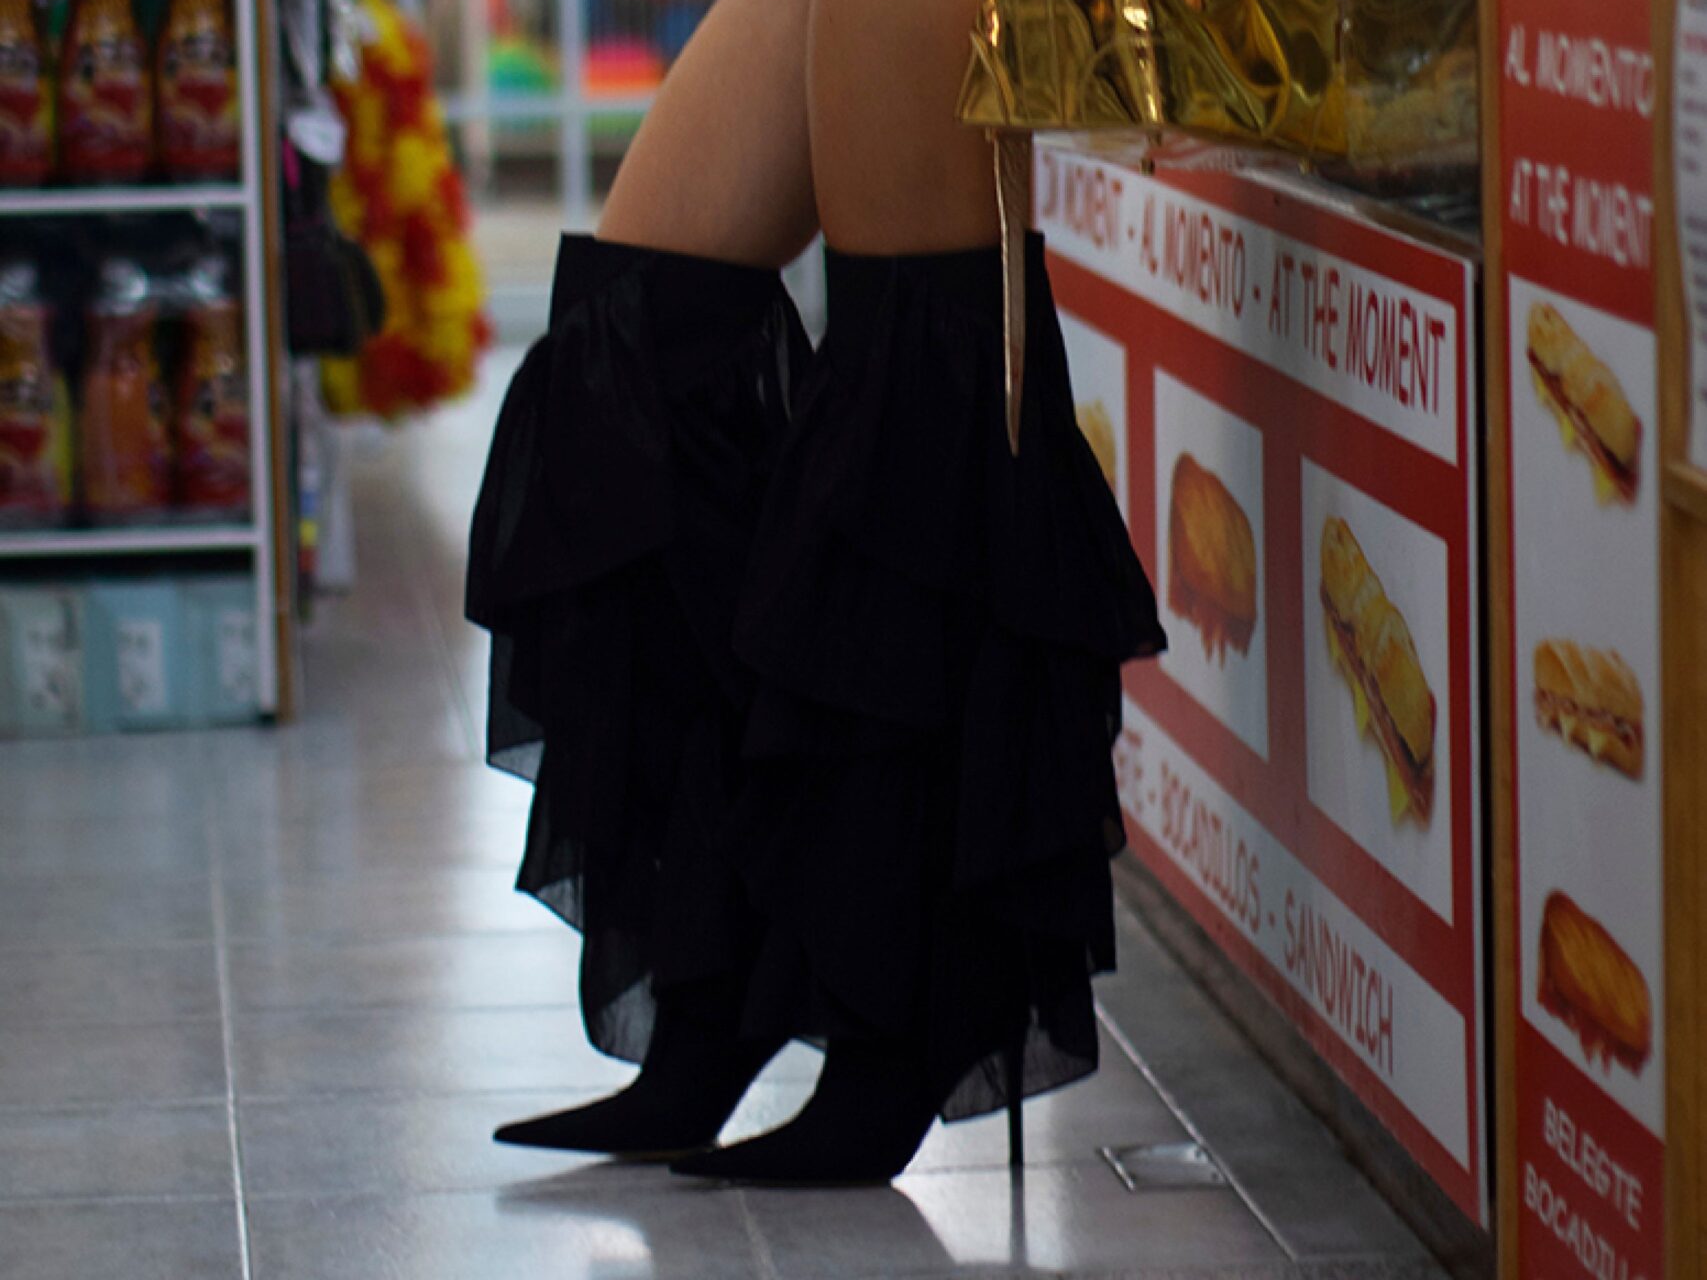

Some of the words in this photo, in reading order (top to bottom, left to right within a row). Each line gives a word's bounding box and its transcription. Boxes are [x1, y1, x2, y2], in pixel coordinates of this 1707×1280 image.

[1535, 31, 1654, 117] MOMENTO
[1536, 163, 1569, 246] THE
[1573, 176, 1654, 269] MOMENT
[1163, 201, 1245, 317] MOMENTO
[1269, 250, 1295, 339] AT
[1301, 260, 1341, 369] THE
[1346, 279, 1446, 415] MOMENT
[1161, 760, 1261, 934] BOCADILLOS
[1284, 887, 1394, 1078] SANDWICH
